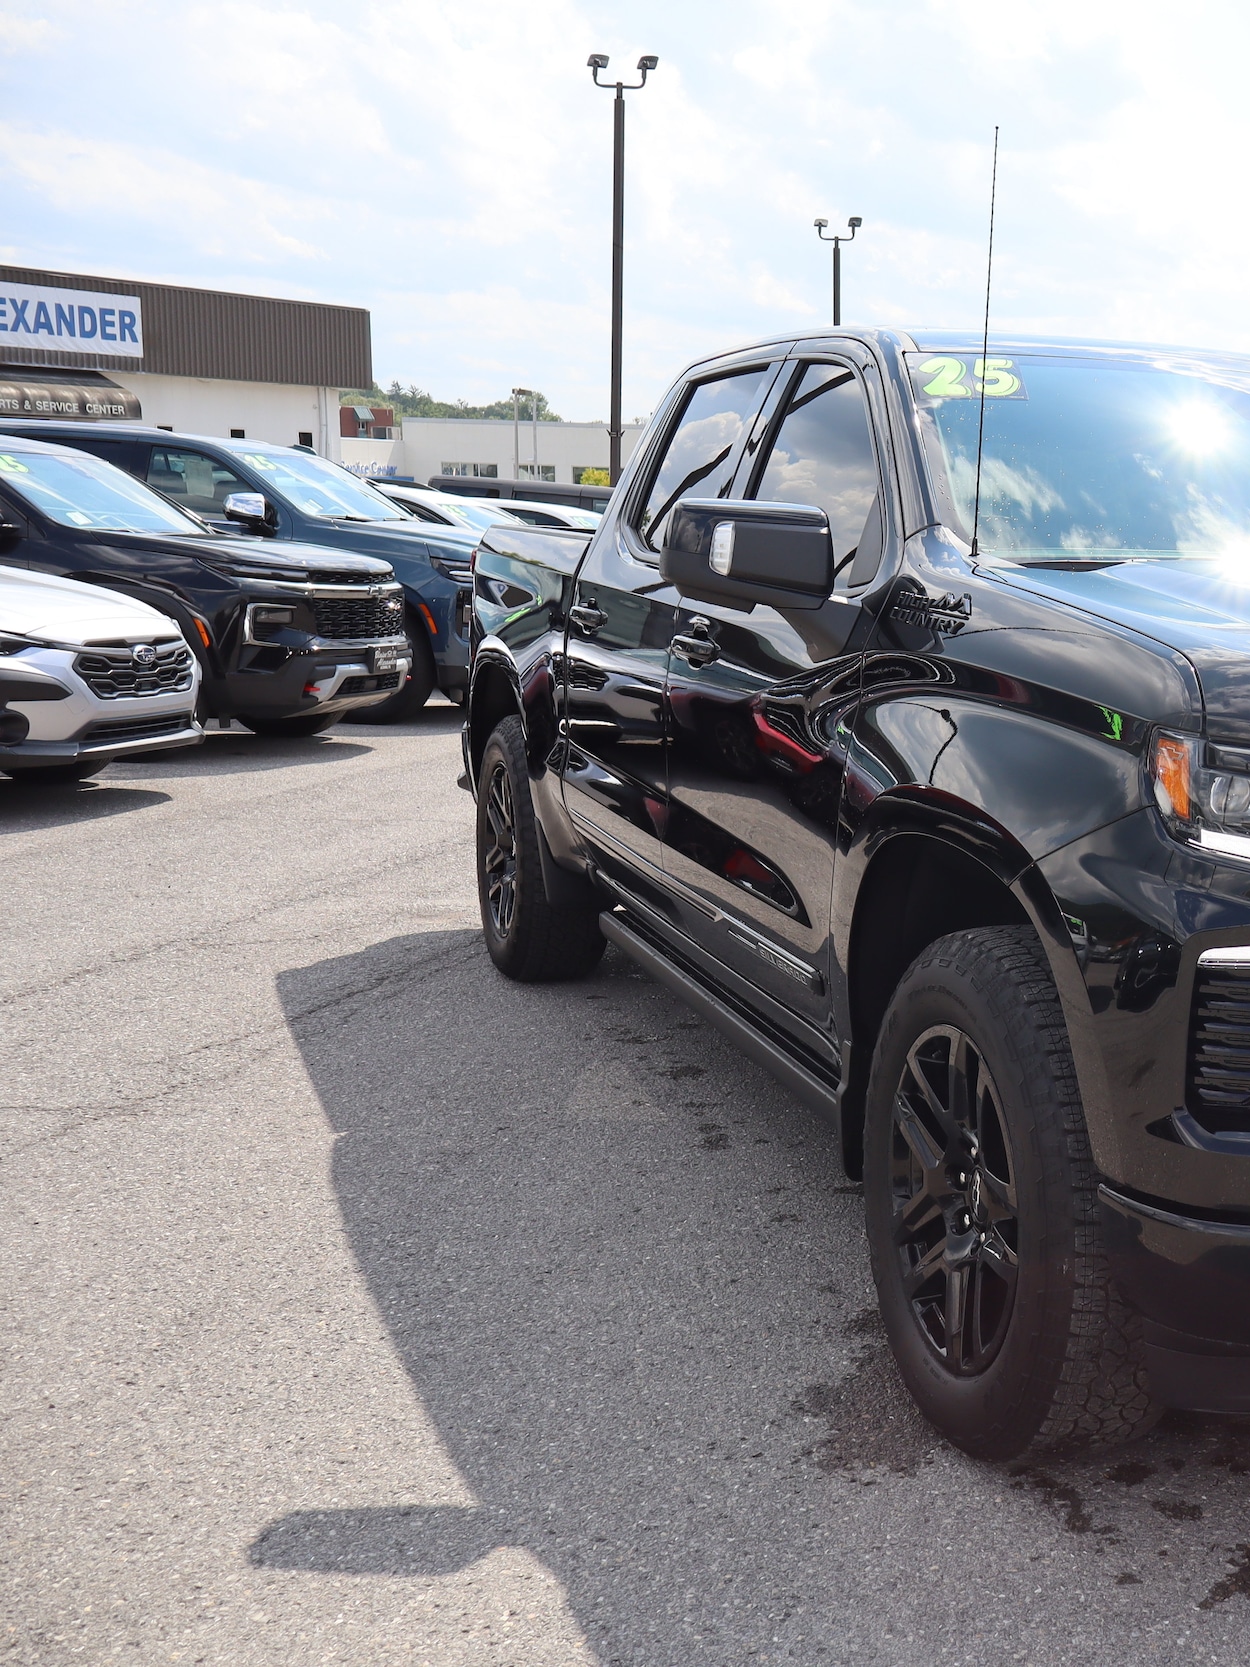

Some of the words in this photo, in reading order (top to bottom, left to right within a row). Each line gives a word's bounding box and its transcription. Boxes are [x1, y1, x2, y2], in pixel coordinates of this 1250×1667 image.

[918, 357, 1021, 396] 25
[24, 400, 31, 411] &
[35, 401, 80, 413] SERVICE
[85, 403, 126, 415] CENTER
[890, 606, 965, 635] COUNTRY
